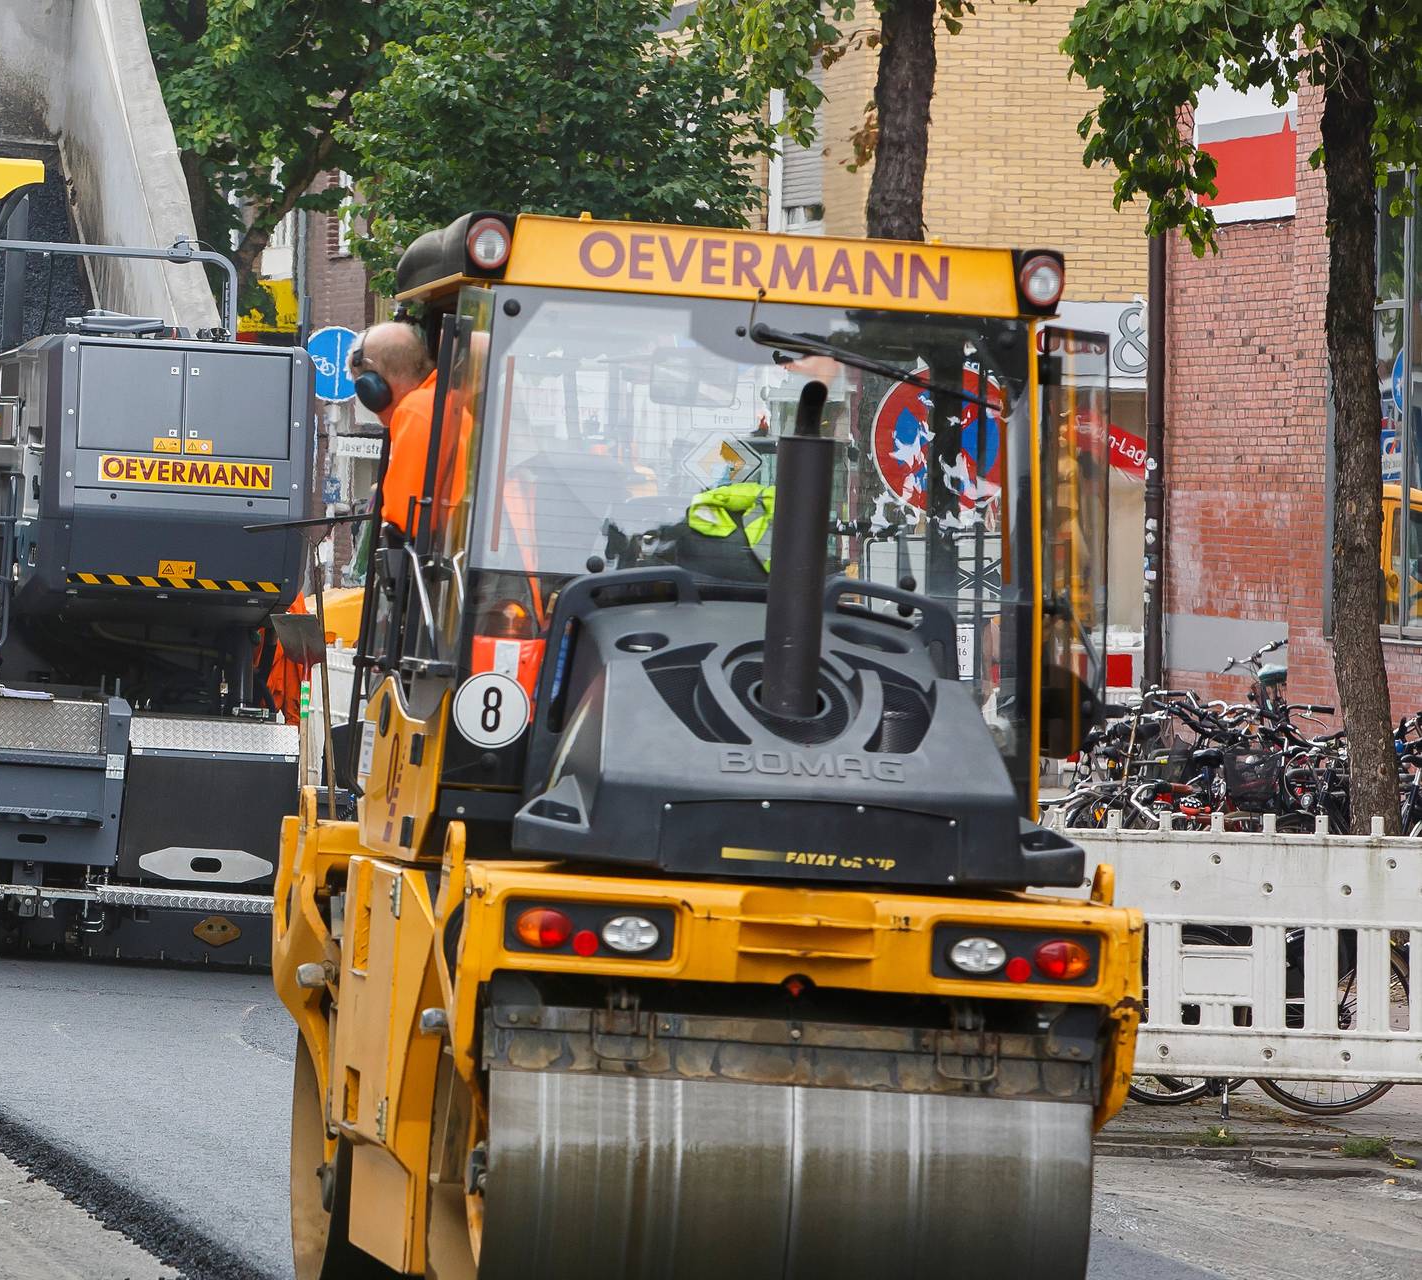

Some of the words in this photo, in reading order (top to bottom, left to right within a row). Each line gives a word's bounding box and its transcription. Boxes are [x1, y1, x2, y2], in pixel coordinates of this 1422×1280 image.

[579, 230, 950, 301] OEVERMANN
[713, 413, 734, 425] frei
[103, 456, 270, 488] OEVERMANN
[481, 687, 502, 732] 8
[720, 750, 906, 783] BOMAG
[785, 851, 837, 866] FAYAT
[839, 857, 896, 871] GRP
